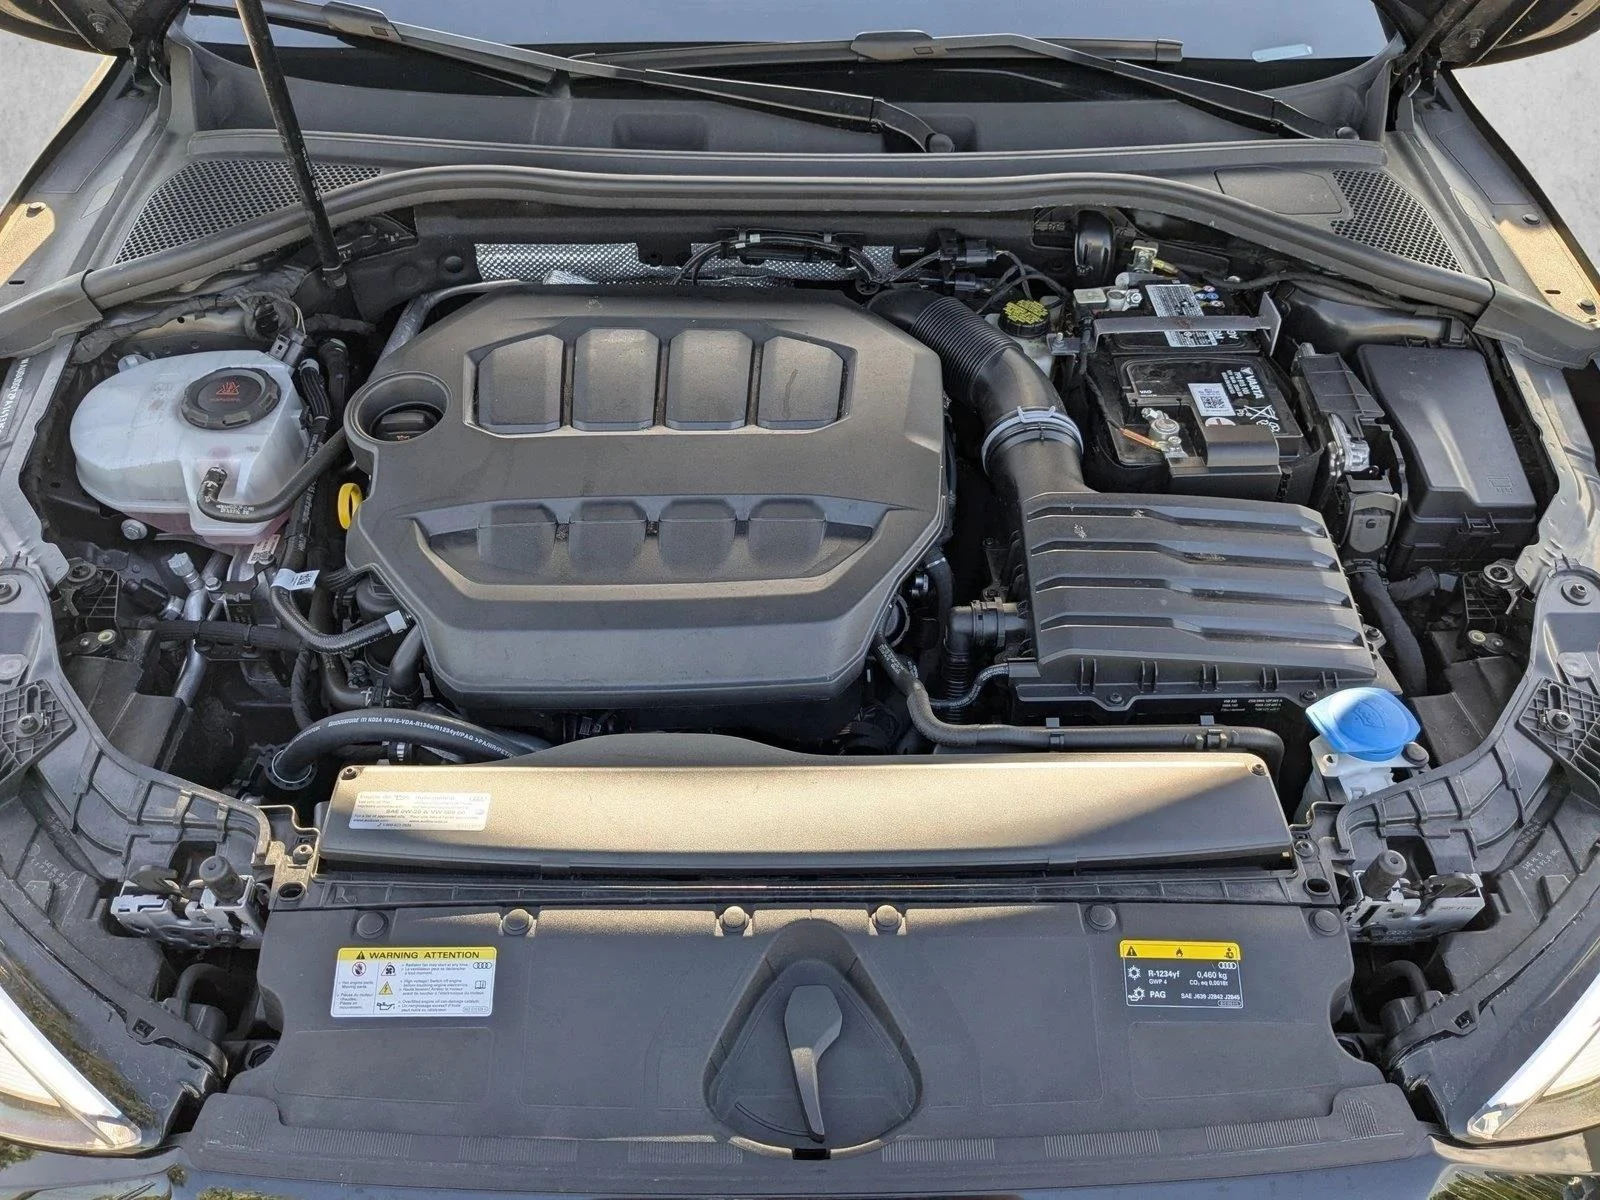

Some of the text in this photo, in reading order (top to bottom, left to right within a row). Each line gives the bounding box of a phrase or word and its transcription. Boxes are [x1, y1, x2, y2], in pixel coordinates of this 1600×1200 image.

[1246, 376, 1264, 398] VARTA
[1148, 970, 1180, 979] R-1234yf
[1218, 971, 1227, 980] kg
